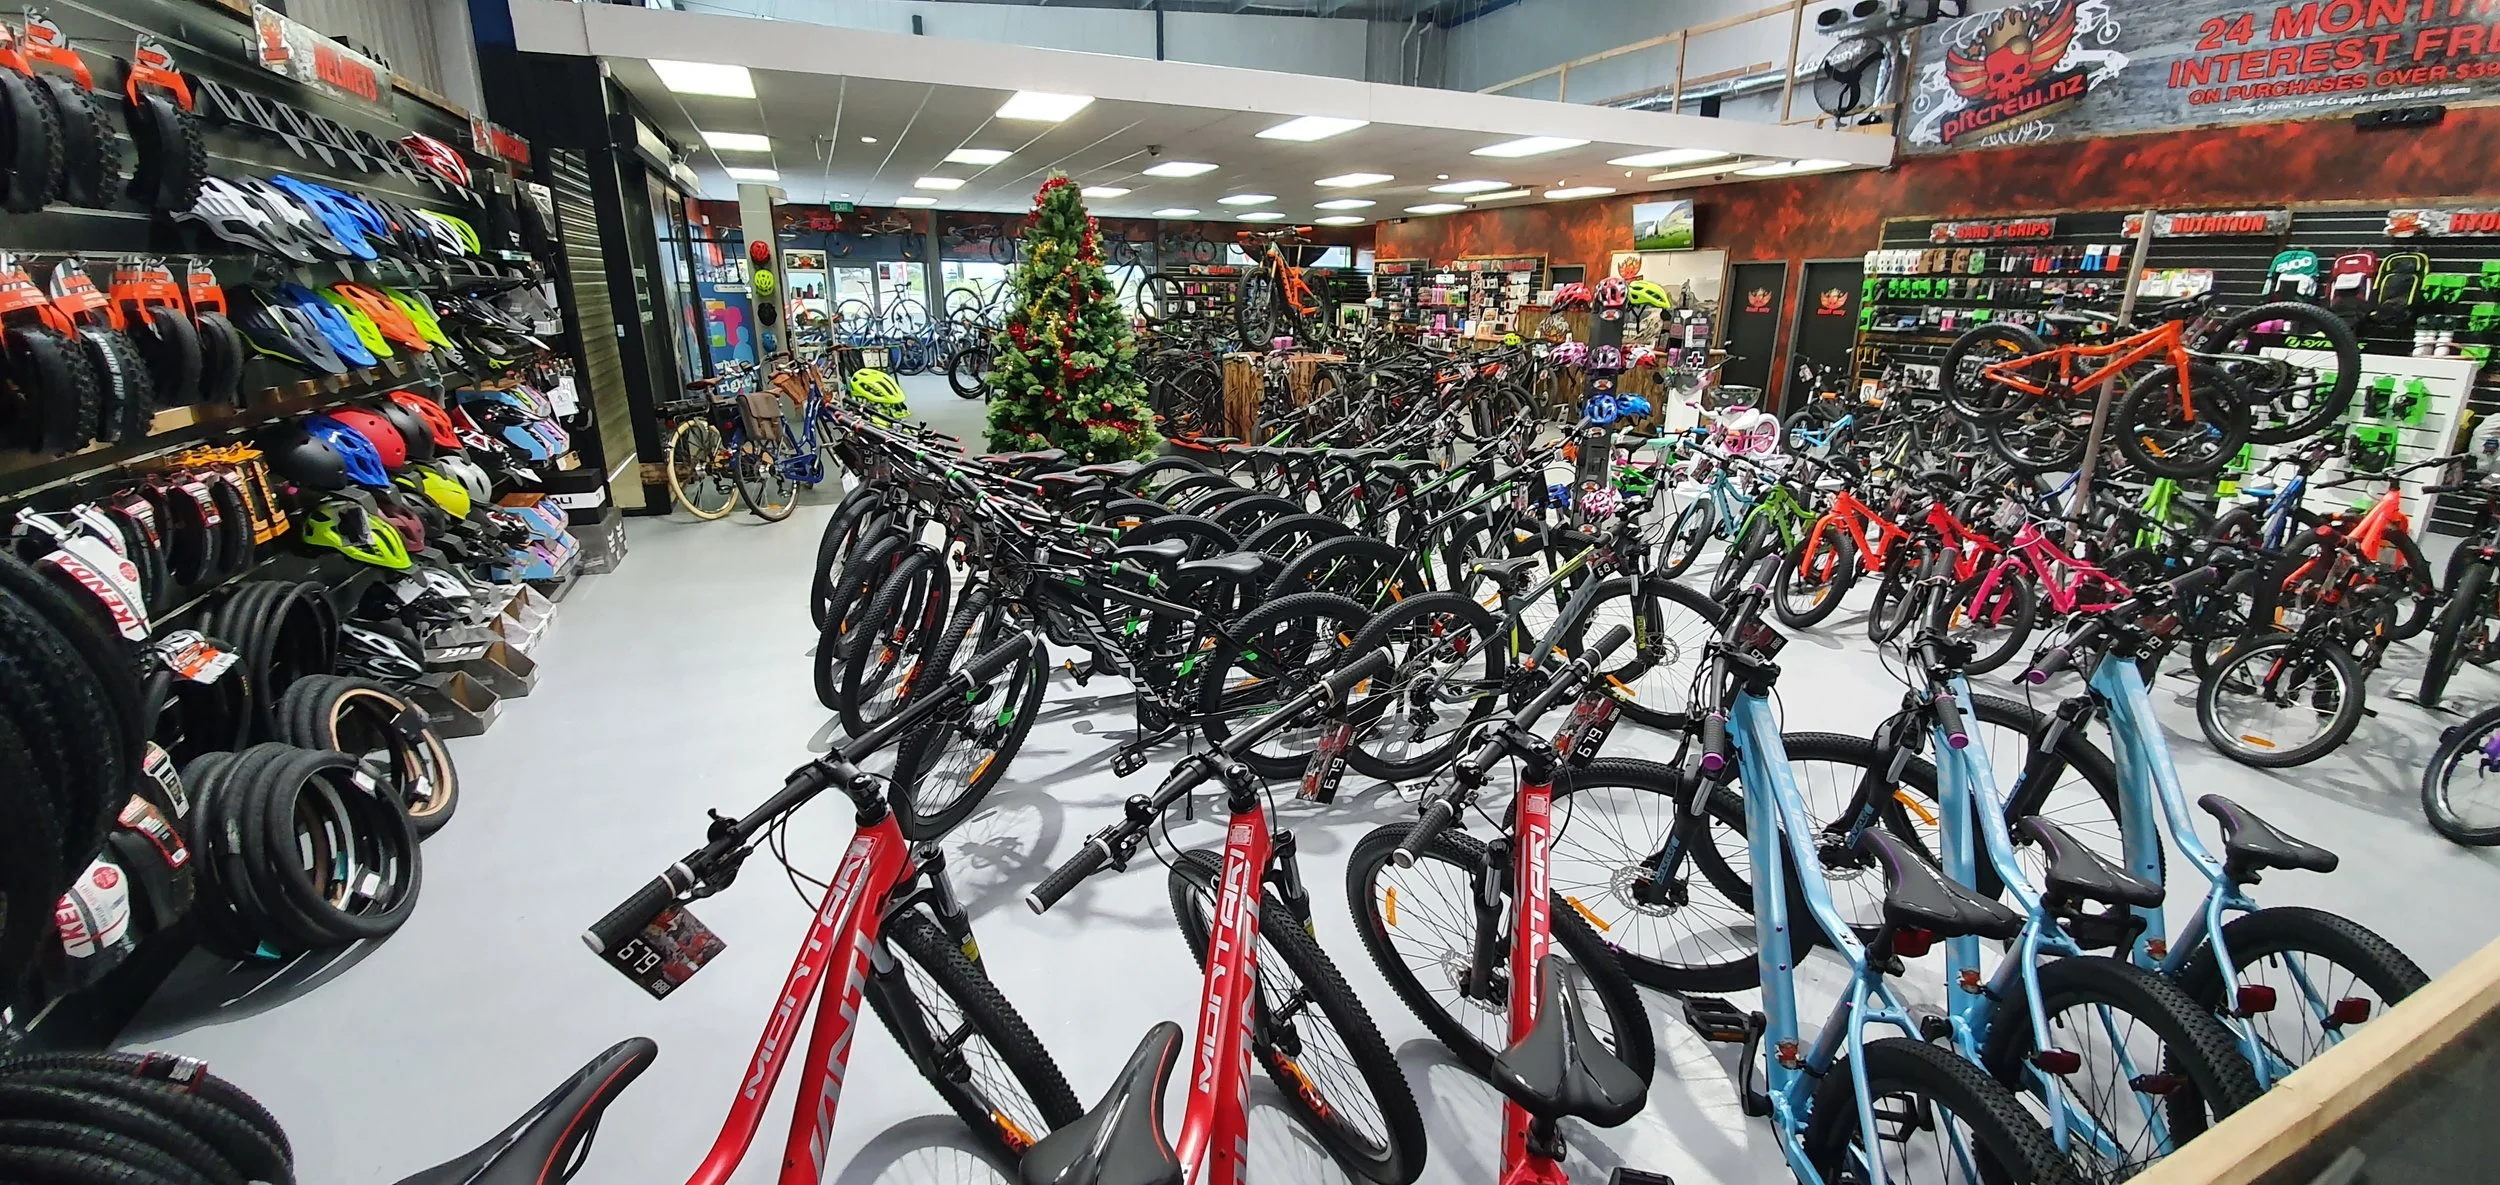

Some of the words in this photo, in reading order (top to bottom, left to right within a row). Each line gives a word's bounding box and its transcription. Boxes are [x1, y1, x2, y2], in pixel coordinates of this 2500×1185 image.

[2195, 13, 2255, 51] 24
[312, 42, 378, 104] HELMETS
[2168, 33, 2401, 88] INTEREST
[2188, 87, 2222, 106] ON
[2224, 72, 2369, 101] PURCHASES
[2375, 65, 2449, 88] OVER
[1943, 73, 2084, 144] pitcrew.nz
[2007, 221, 2050, 238] GRIPS
[2170, 215, 2267, 232] NUTRITION
[57, 554, 133, 623] KENDA
[1576, 727, 1604, 758] 679
[1322, 756, 1345, 791] 679
[617, 938, 662, 975] 679
[1199, 847, 1245, 1093] MONTARI
